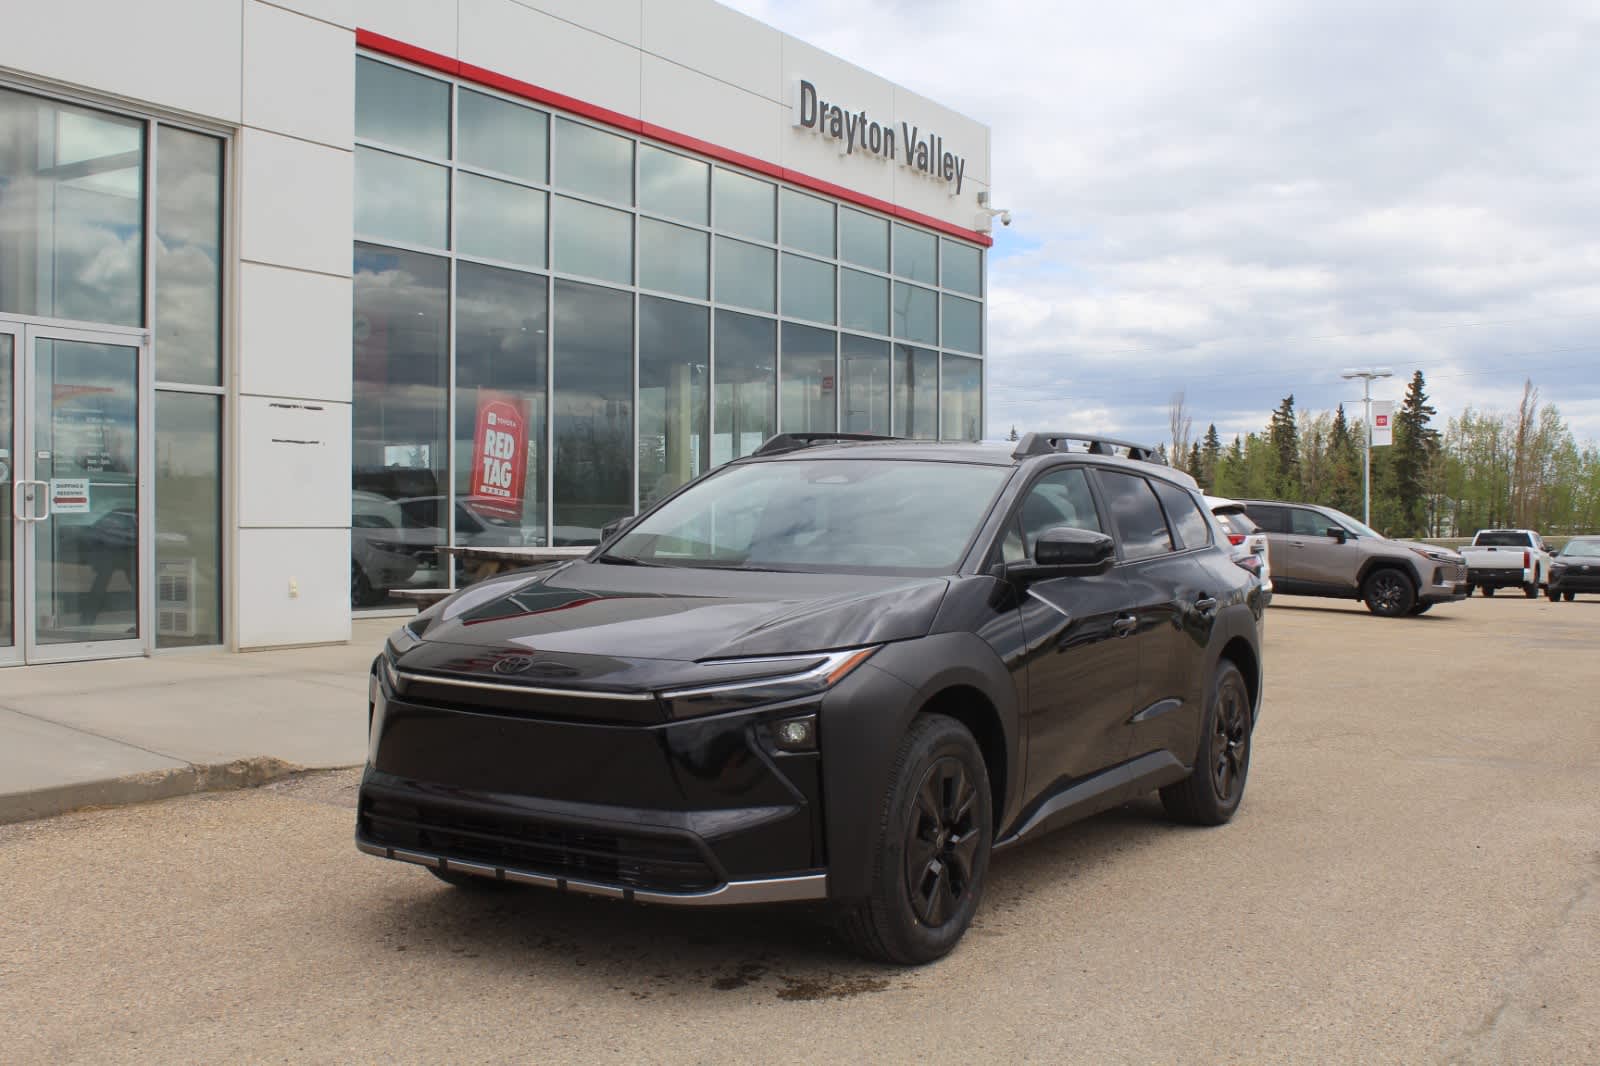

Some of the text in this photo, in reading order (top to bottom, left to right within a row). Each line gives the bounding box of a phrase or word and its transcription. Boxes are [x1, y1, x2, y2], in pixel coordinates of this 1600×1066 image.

[800, 79, 965, 195] Drayton Valley
[484, 429, 514, 460] RED
[483, 456, 512, 489] TAG
